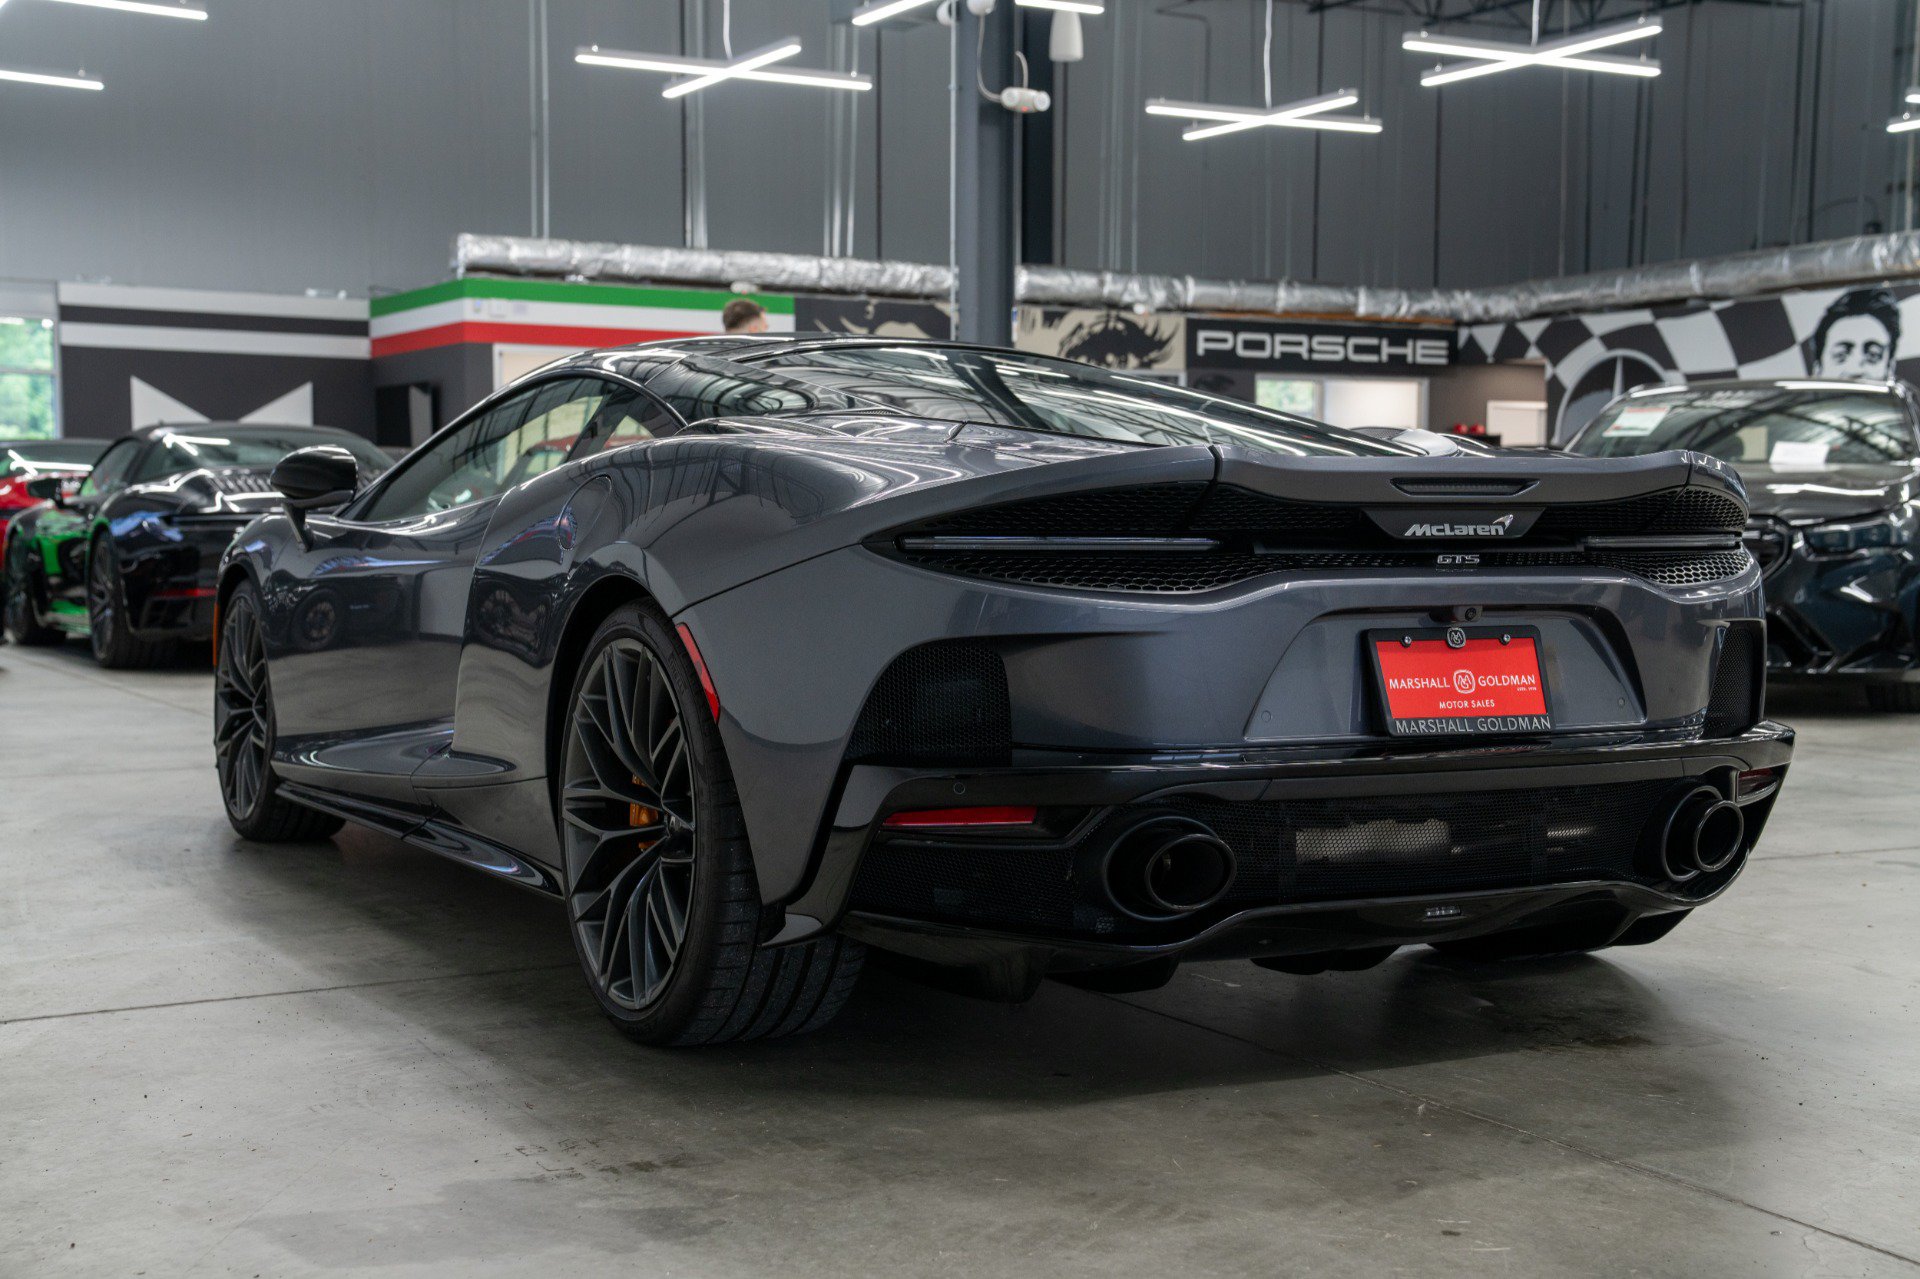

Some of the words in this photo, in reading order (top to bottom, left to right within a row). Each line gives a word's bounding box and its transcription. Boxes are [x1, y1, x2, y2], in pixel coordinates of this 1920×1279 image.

[1196, 329, 1450, 365] PORSCHE
[1404, 523, 1505, 537] McLaren
[1437, 554, 1480, 565] GTS
[1389, 676, 1450, 690] MARSHALL
[1477, 674, 1536, 687] GOLDMAN
[1439, 700, 1469, 710] MOTOR
[1471, 699, 1495, 709] SALES
[1395, 718, 1474, 735] MARSHALL
[1476, 715, 1552, 732] GOLDMAN
